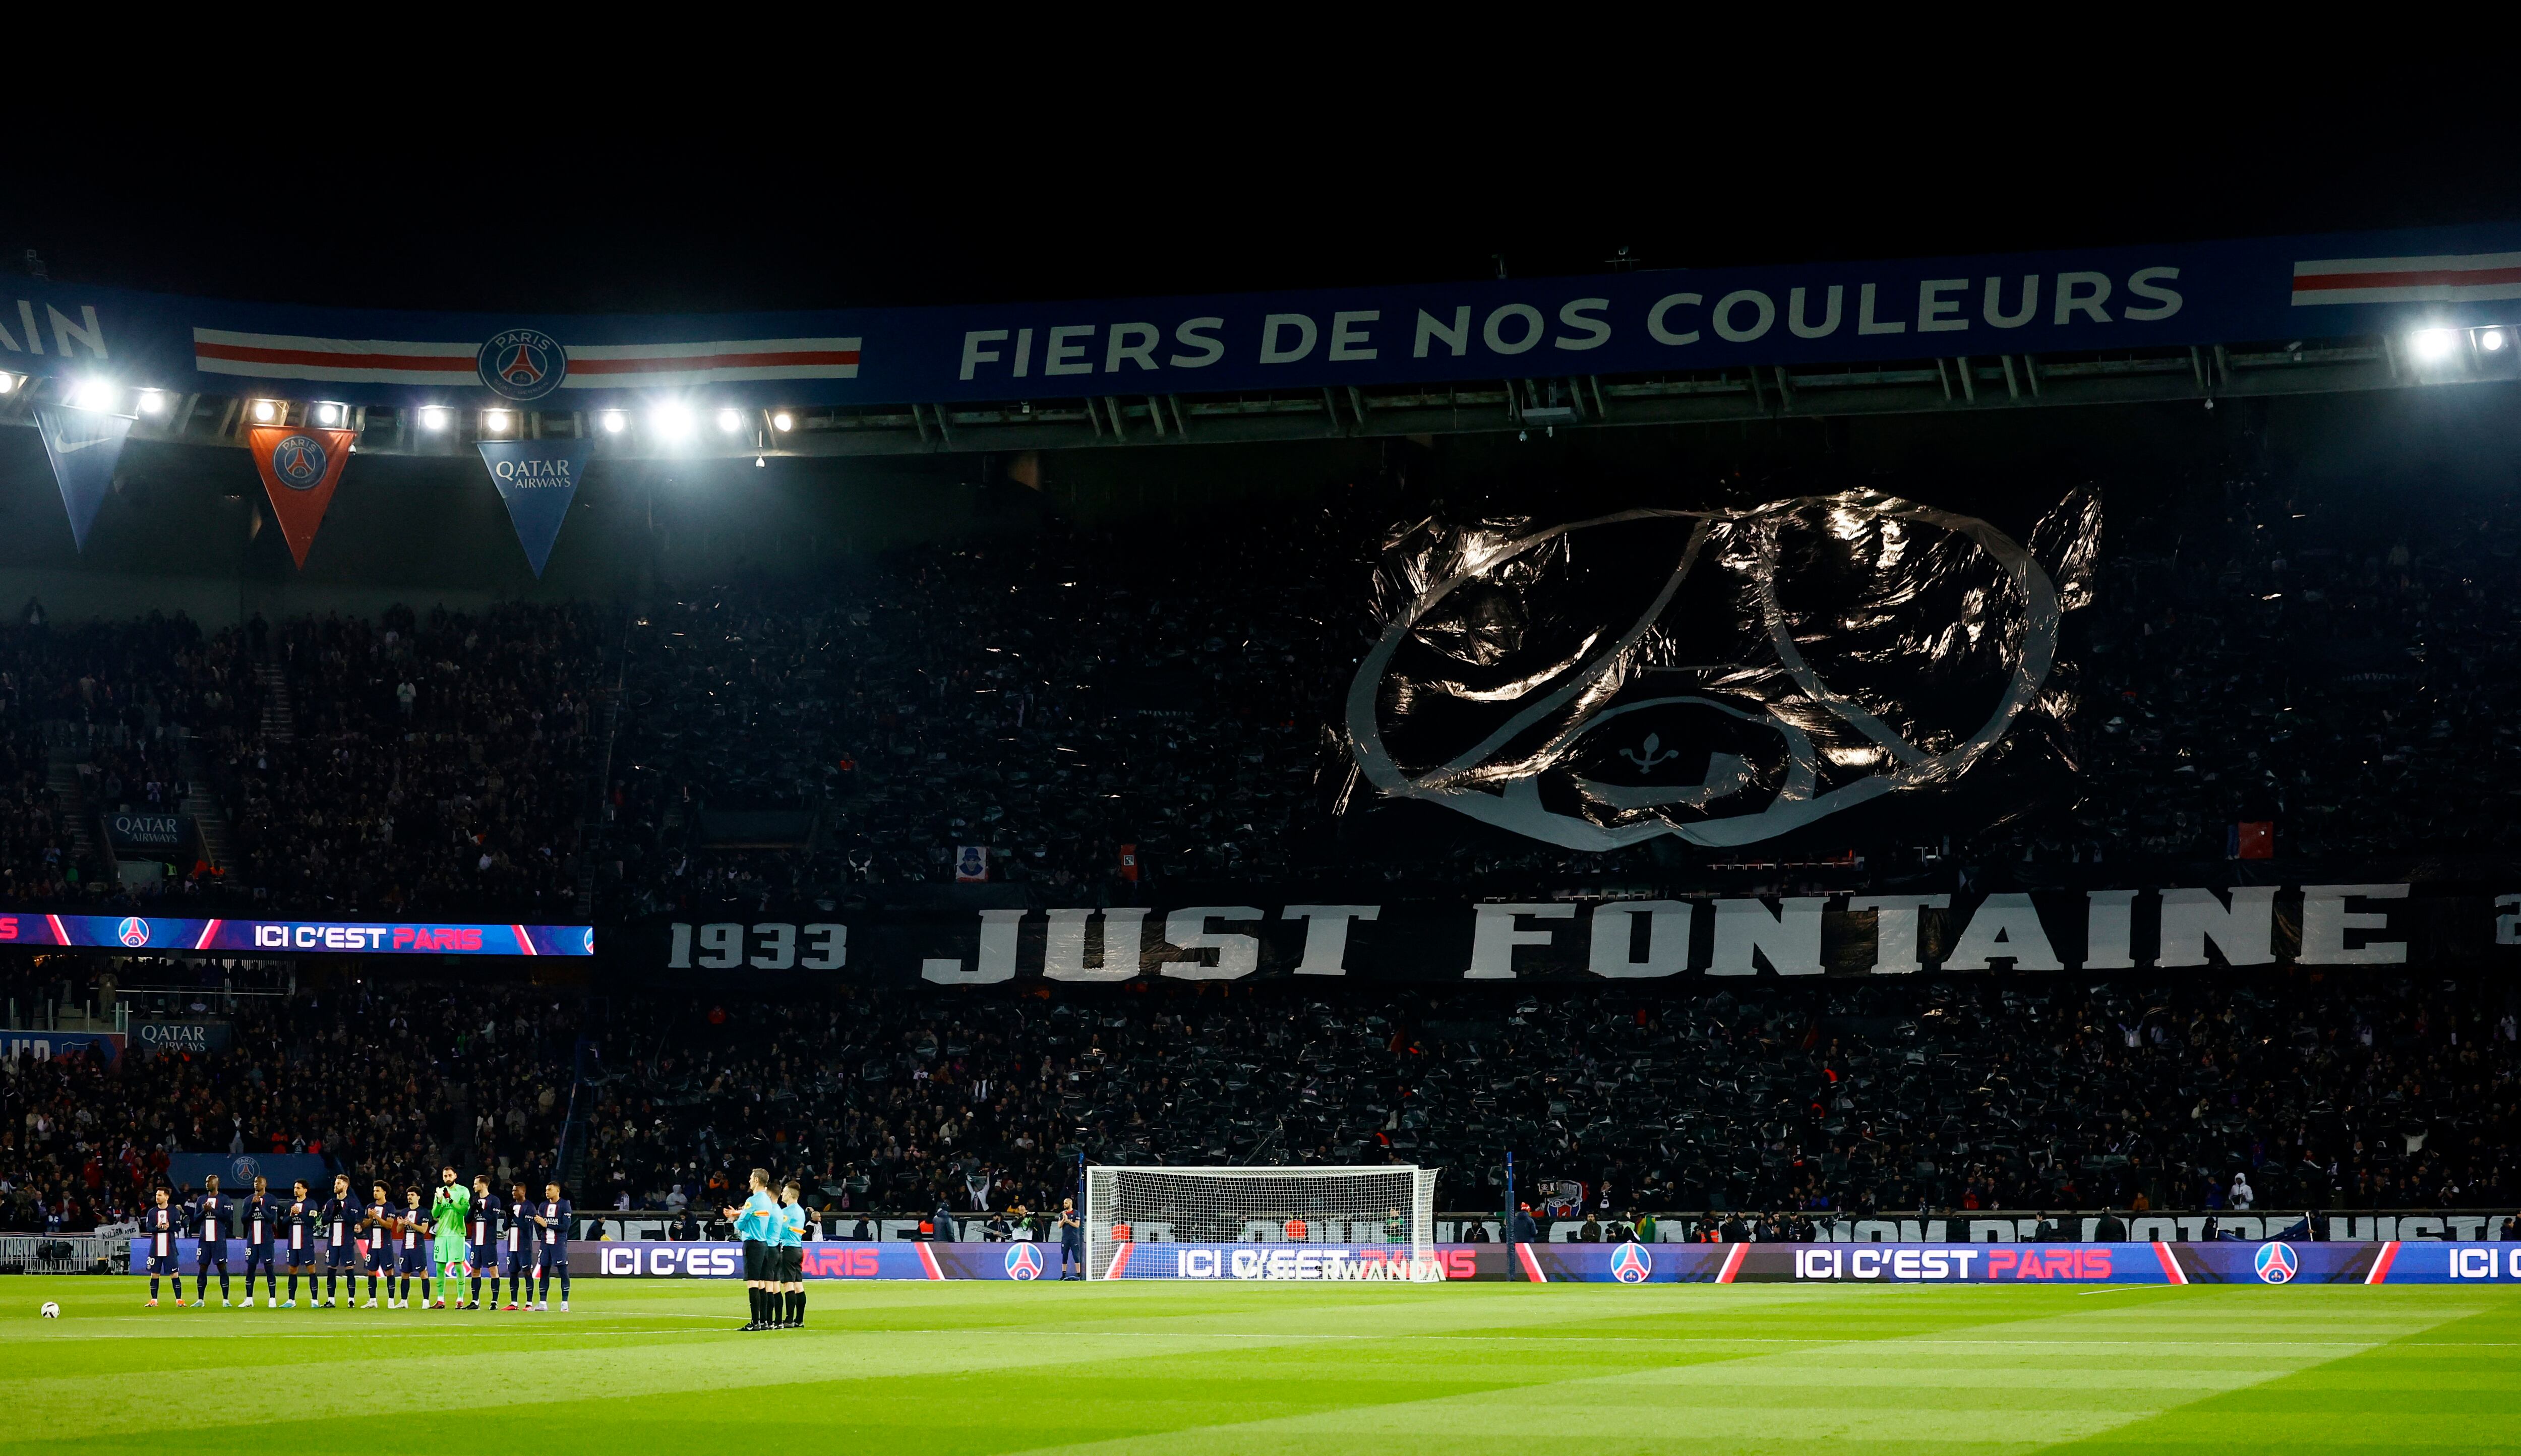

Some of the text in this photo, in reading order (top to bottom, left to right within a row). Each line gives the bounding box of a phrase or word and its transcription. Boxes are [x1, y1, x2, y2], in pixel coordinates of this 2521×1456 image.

[959, 267, 2184, 380] FIERS DE NOS COULEURS
[495, 332, 551, 350] PARIS
[282, 439, 317, 452] PARIS
[496, 460, 570, 481] QATAR
[515, 477, 571, 488] AIRWAYS
[116, 817, 176, 834] QATAR
[132, 833, 177, 842] AIRWAYS
[255, 925, 482, 950] ICI C'EST PARIS
[668, 923, 848, 969] 1933
[922, 905, 1381, 985] JUST
[1464, 883, 2411, 979] FONTAINE
[142, 1025, 205, 1043] QATAR
[146, 1256, 155, 1265] 30
[245, 1247, 251, 1256] 26
[325, 1250, 329, 1258] 4
[470, 1251, 474, 1259] 8
[601, 1248, 641, 1275] ICI
[801, 1248, 878, 1276] ARIS
[1178, 1250, 1221, 1278] ICI
[1236, 1260, 1447, 1281] VISIT RWANDA
[1795, 1249, 2113, 1279] ICI C'EST PARIS
[2450, 1248, 2498, 1278] ICI
